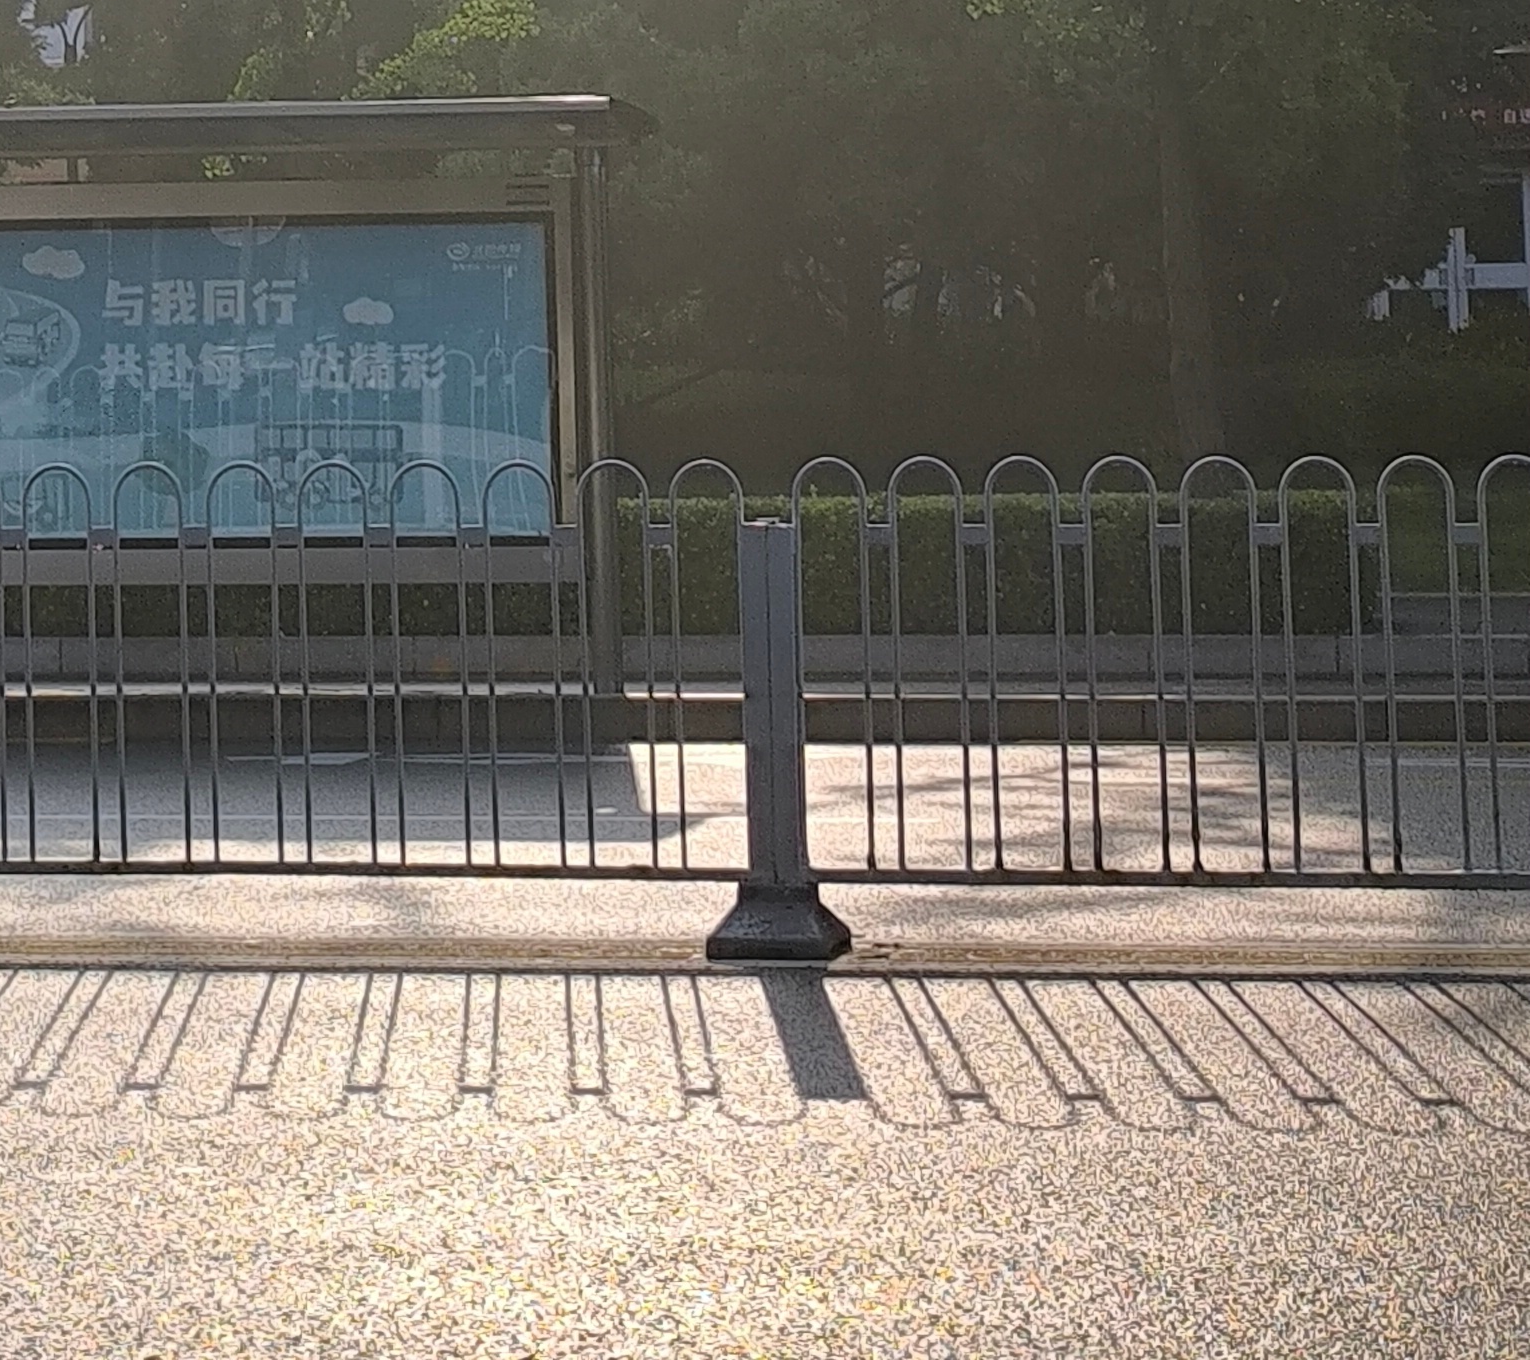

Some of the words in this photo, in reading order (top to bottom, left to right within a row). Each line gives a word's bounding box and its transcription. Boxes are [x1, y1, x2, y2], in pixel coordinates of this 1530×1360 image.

[101, 277, 298, 327] 与我同行
[98, 340, 447, 391] 共赴每一站精彩
